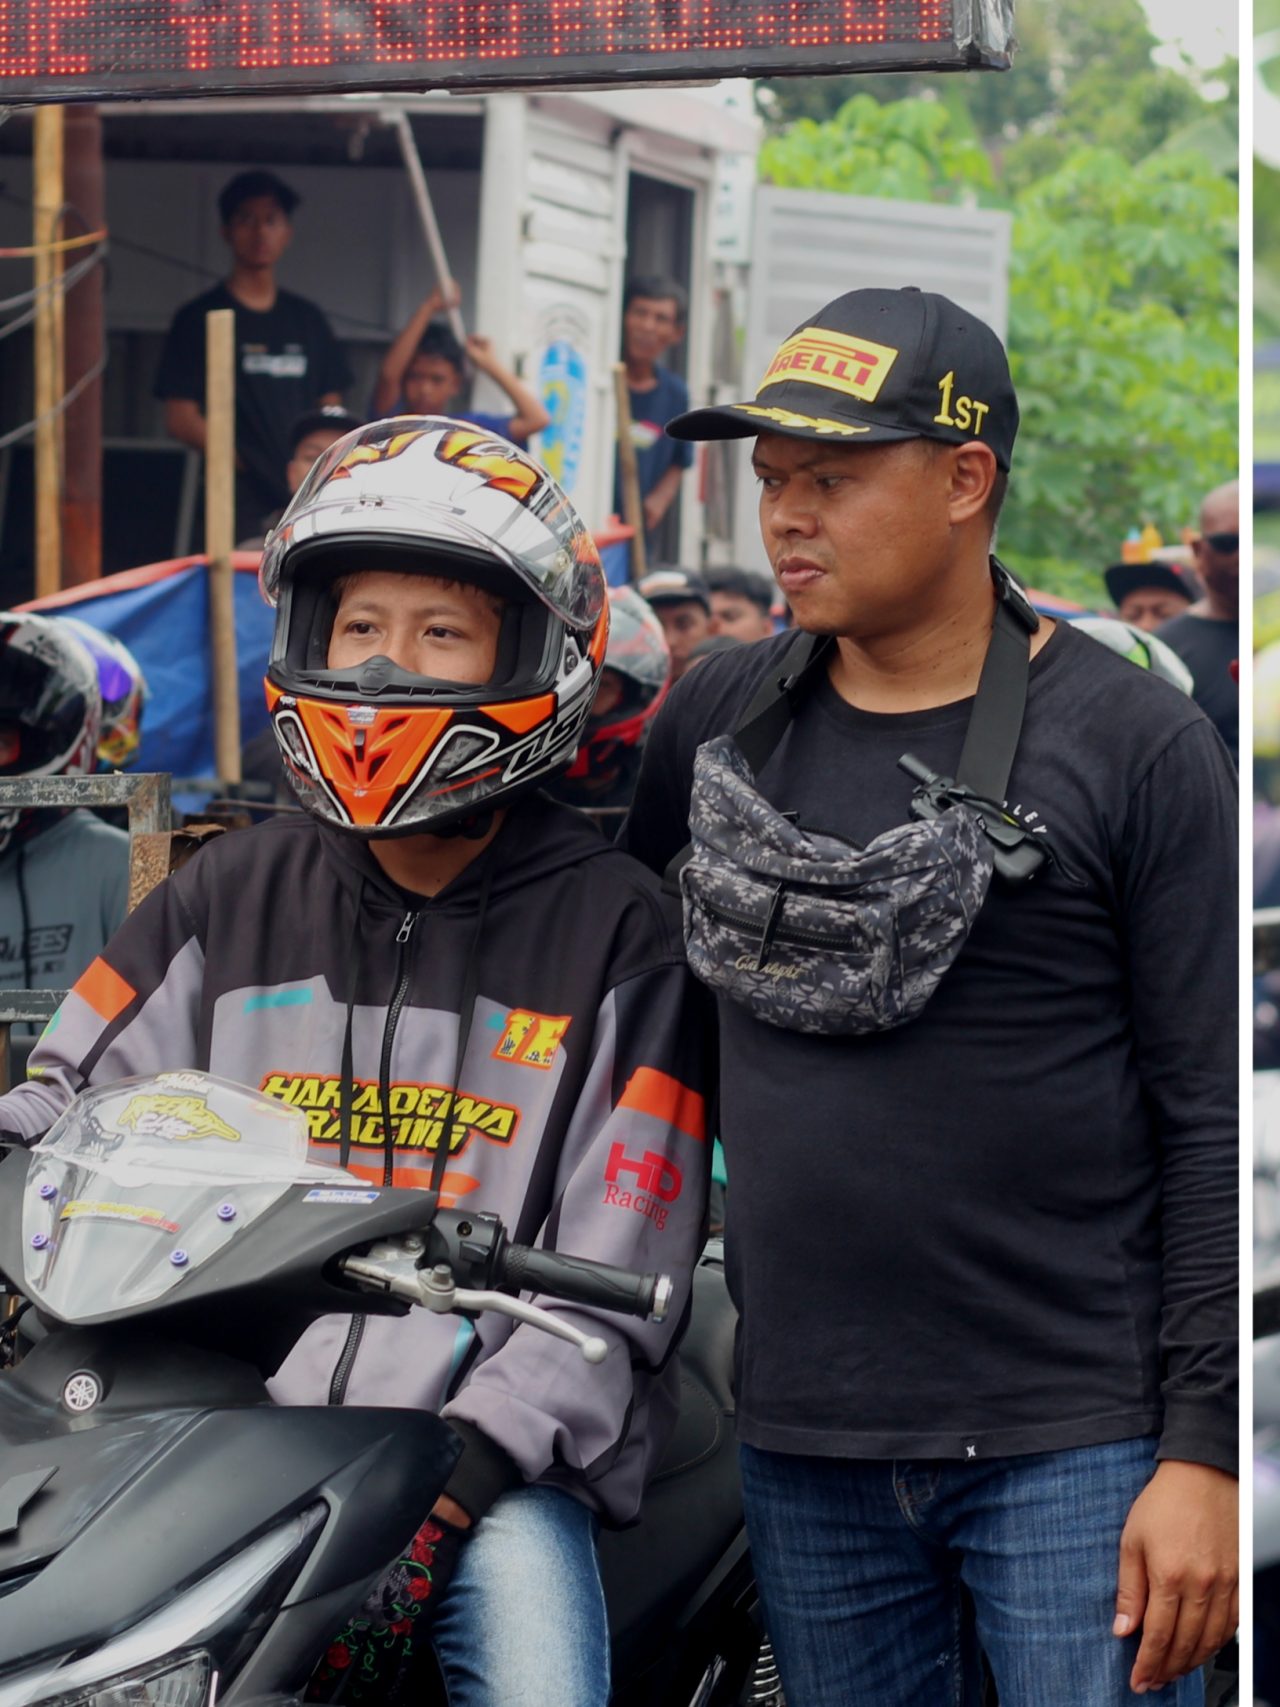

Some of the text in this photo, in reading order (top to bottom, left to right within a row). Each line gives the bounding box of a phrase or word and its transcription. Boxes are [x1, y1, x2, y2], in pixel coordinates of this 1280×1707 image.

[934, 370, 990, 435] 1ST
[304, 1108, 468, 1150] RACING
[602, 1182, 671, 1232] Racing
